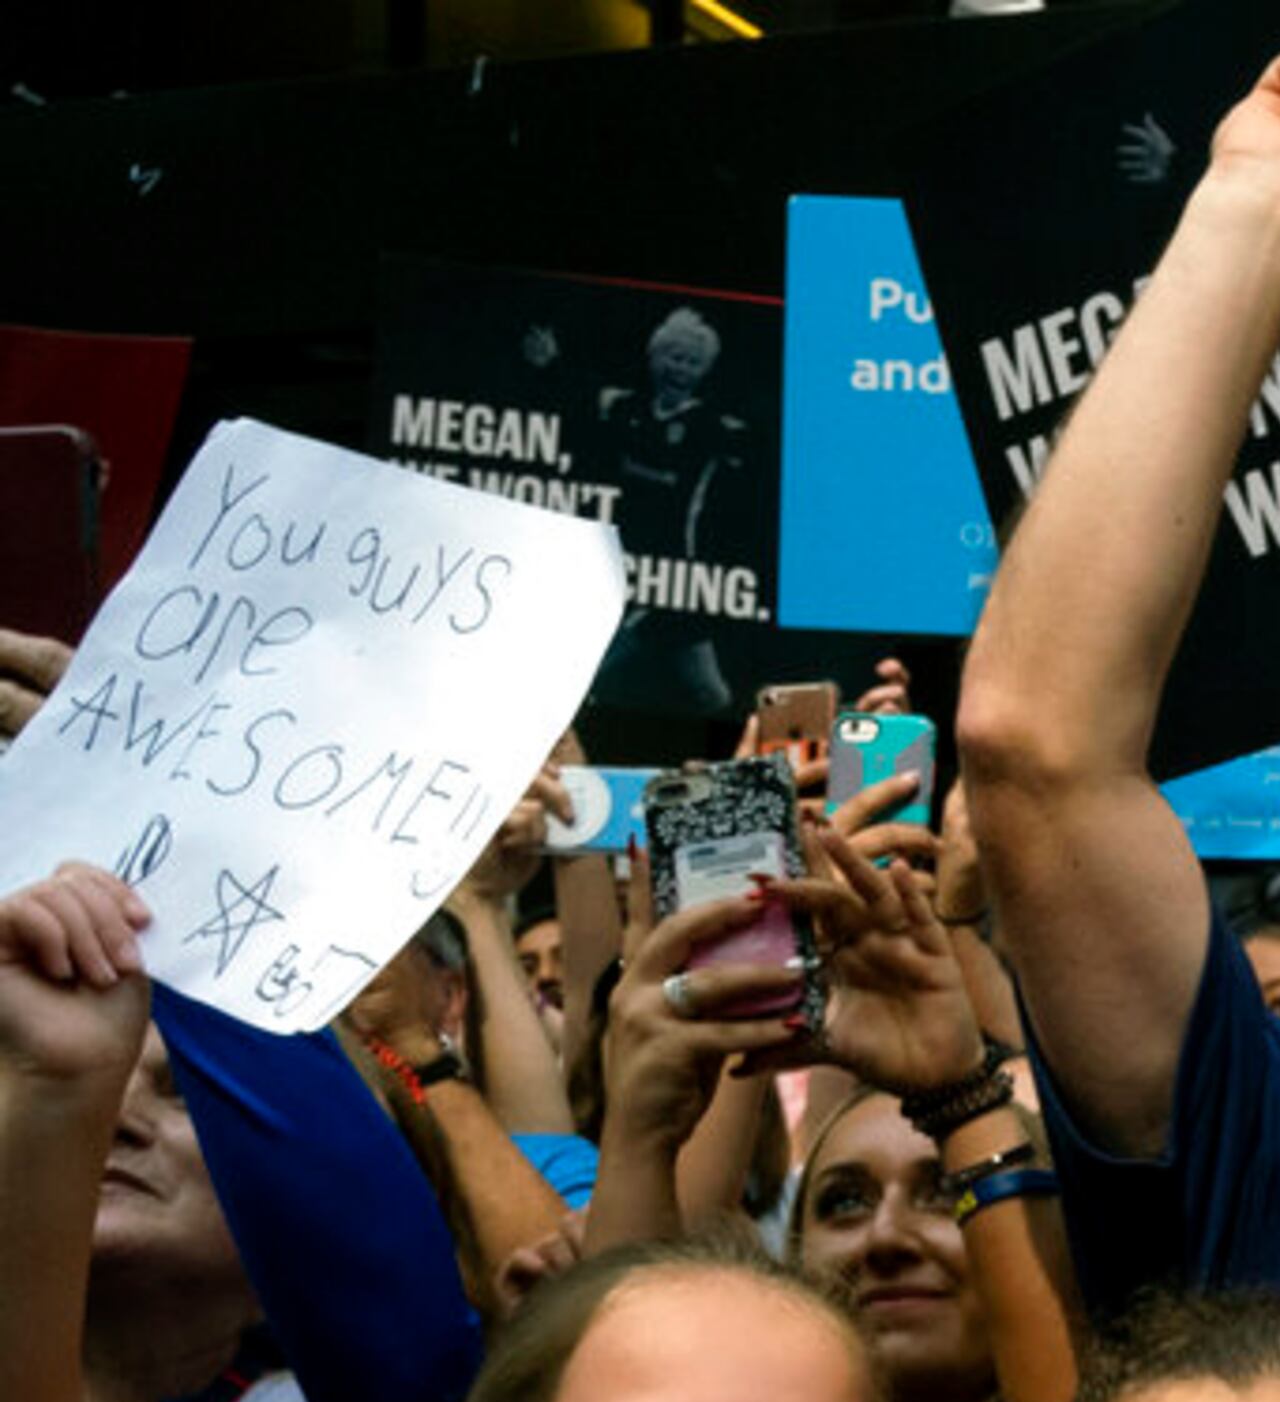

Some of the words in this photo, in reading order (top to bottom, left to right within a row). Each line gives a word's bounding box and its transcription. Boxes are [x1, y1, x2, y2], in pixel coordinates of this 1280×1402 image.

[850, 350, 951, 393] and
[391, 394, 573, 473] MEGAN,
[190, 464, 327, 572] You
[135, 586, 313, 684] are
